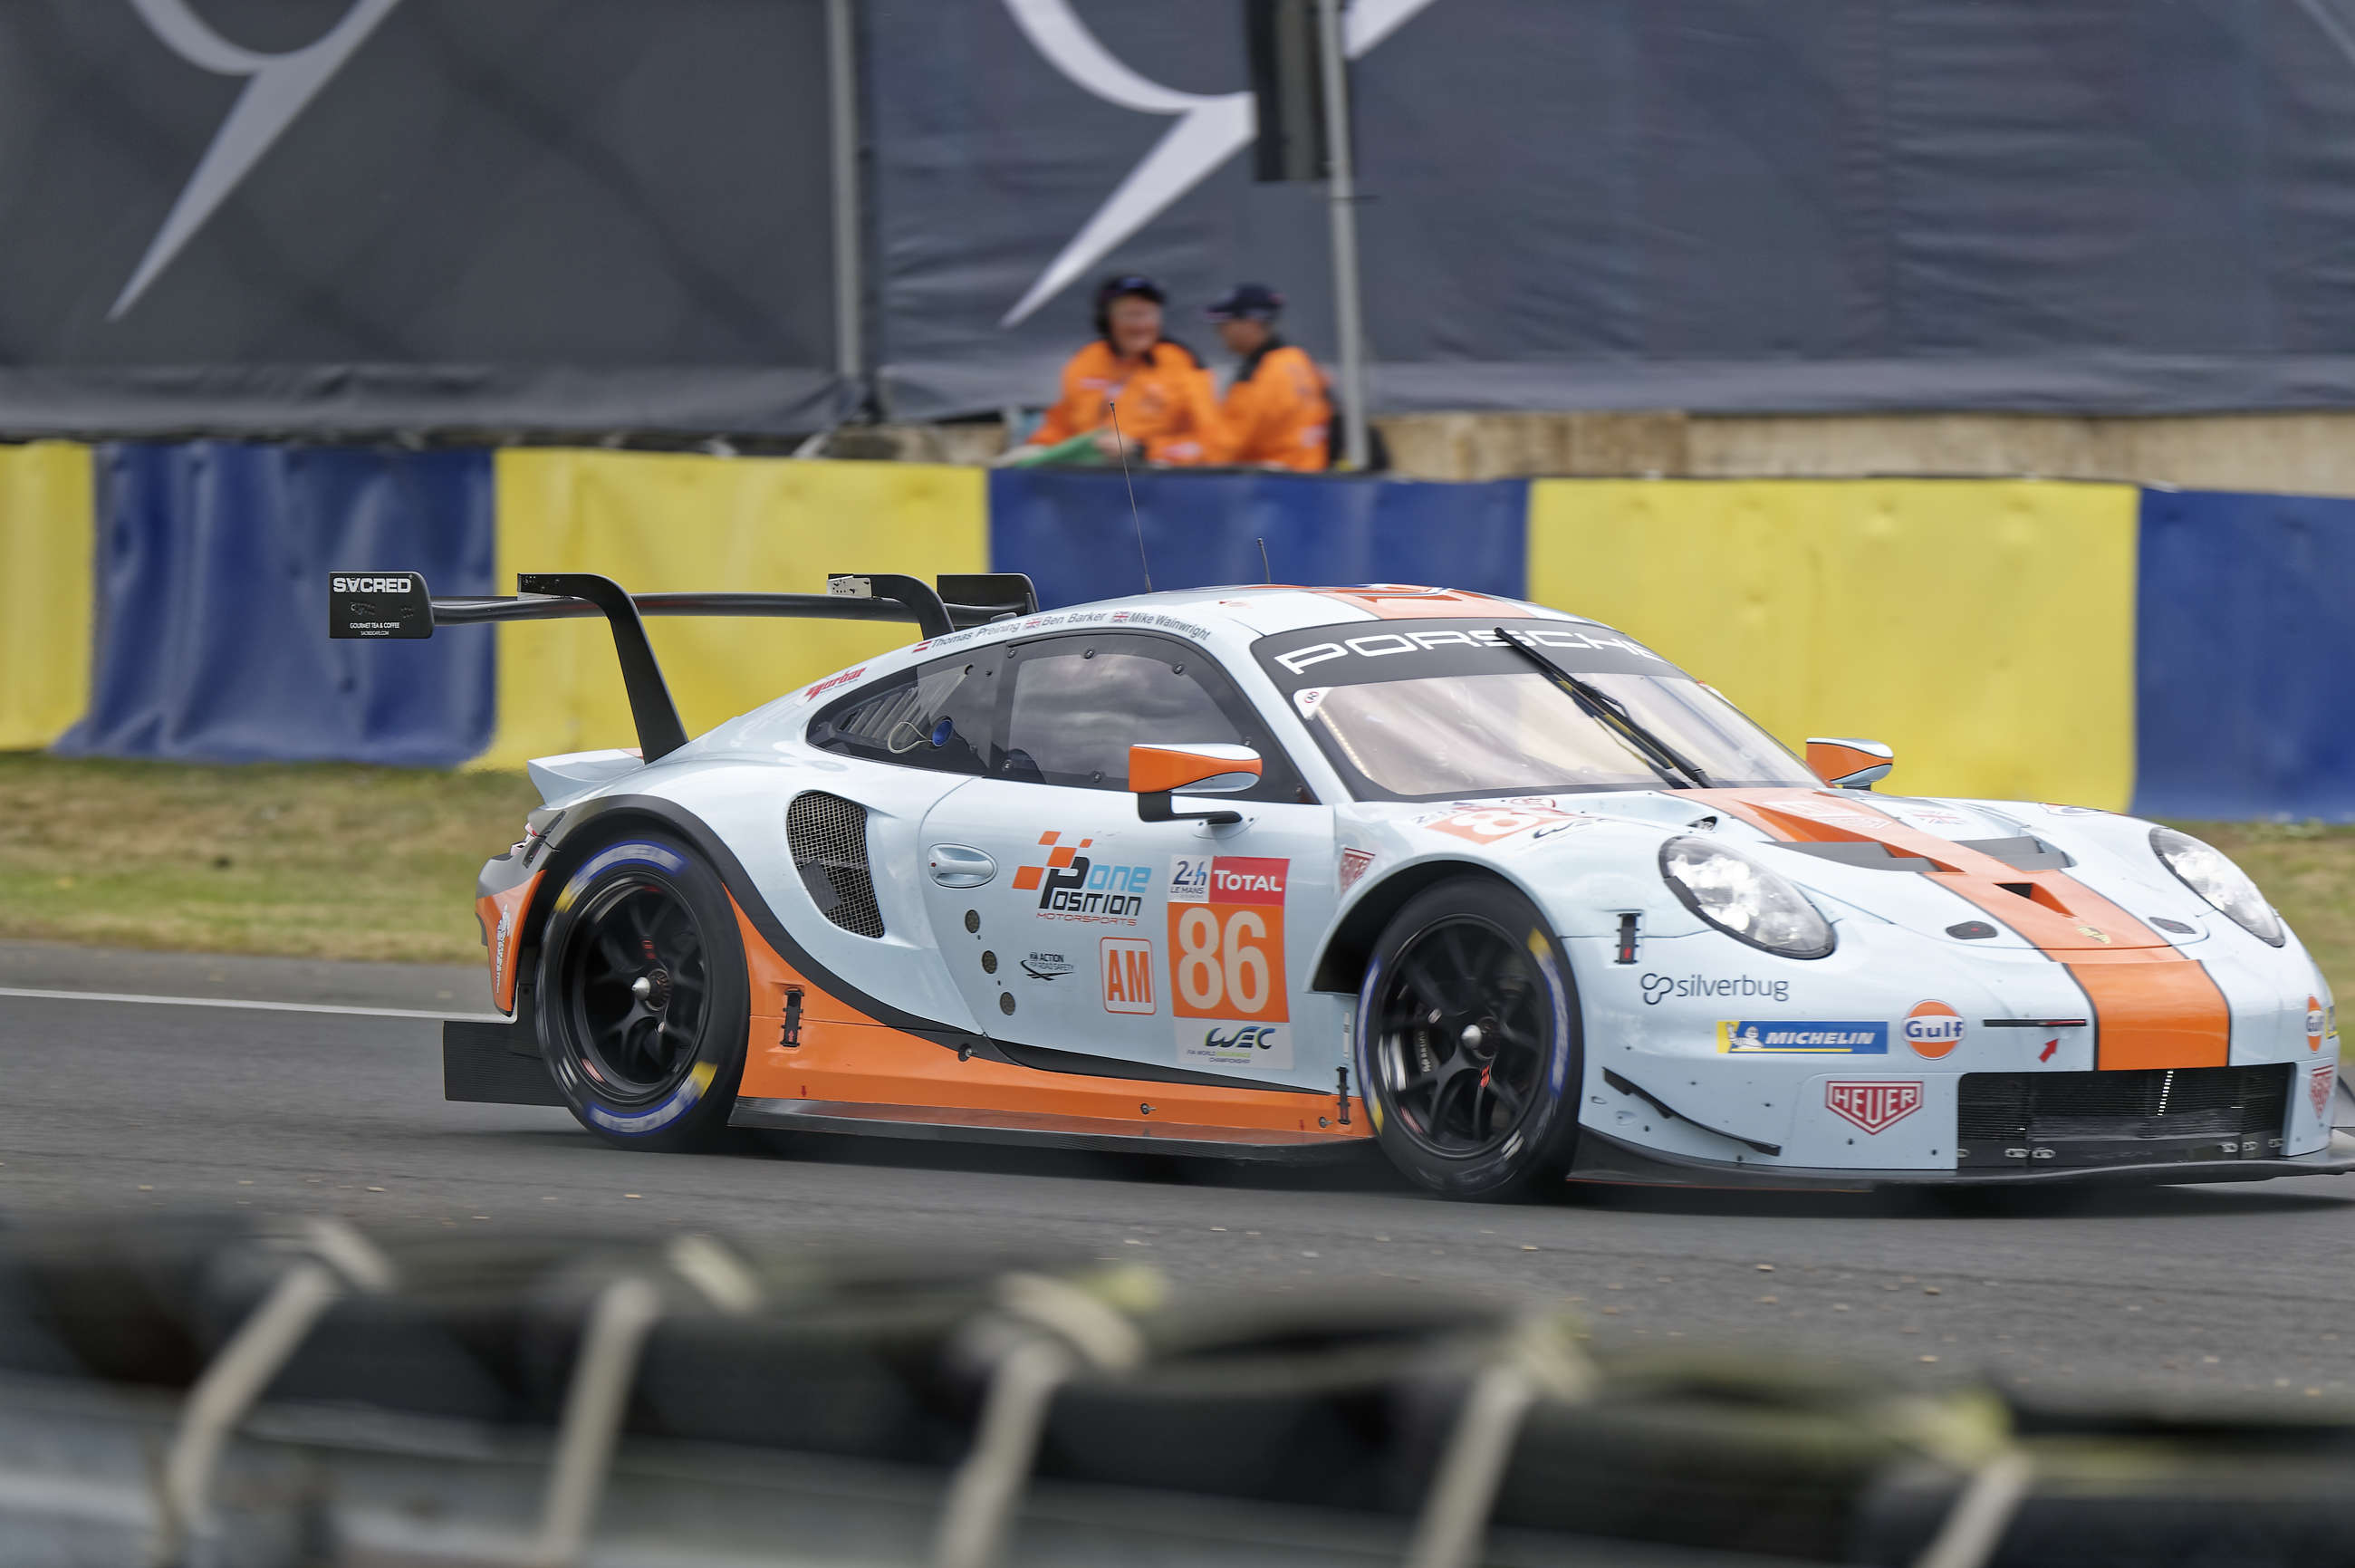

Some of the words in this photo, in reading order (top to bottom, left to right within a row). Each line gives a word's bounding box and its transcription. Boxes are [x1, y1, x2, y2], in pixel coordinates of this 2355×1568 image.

[332, 577, 411, 593] SACRED
[1042, 616, 1064, 627] Ben
[1067, 611, 1107, 623] Barker
[1129, 612, 1153, 624] Mike
[1155, 614, 1212, 641] Wainwright
[931, 631, 973, 649] Thomas
[1214, 870, 1283, 891] TOTAL
[1036, 912, 1137, 926] MOTORSPORTS
[1040, 953, 1064, 963] ACTION
[1179, 907, 1270, 1013] 86
[1108, 949, 1151, 1003] AM
[1676, 975, 1789, 1002] silverbug
[1205, 1026, 1275, 1050] WEC
[1765, 1033, 1875, 1044] MICHELIN
[1906, 1020, 1964, 1038] Gulf
[1833, 1090, 1915, 1125] HEUER
